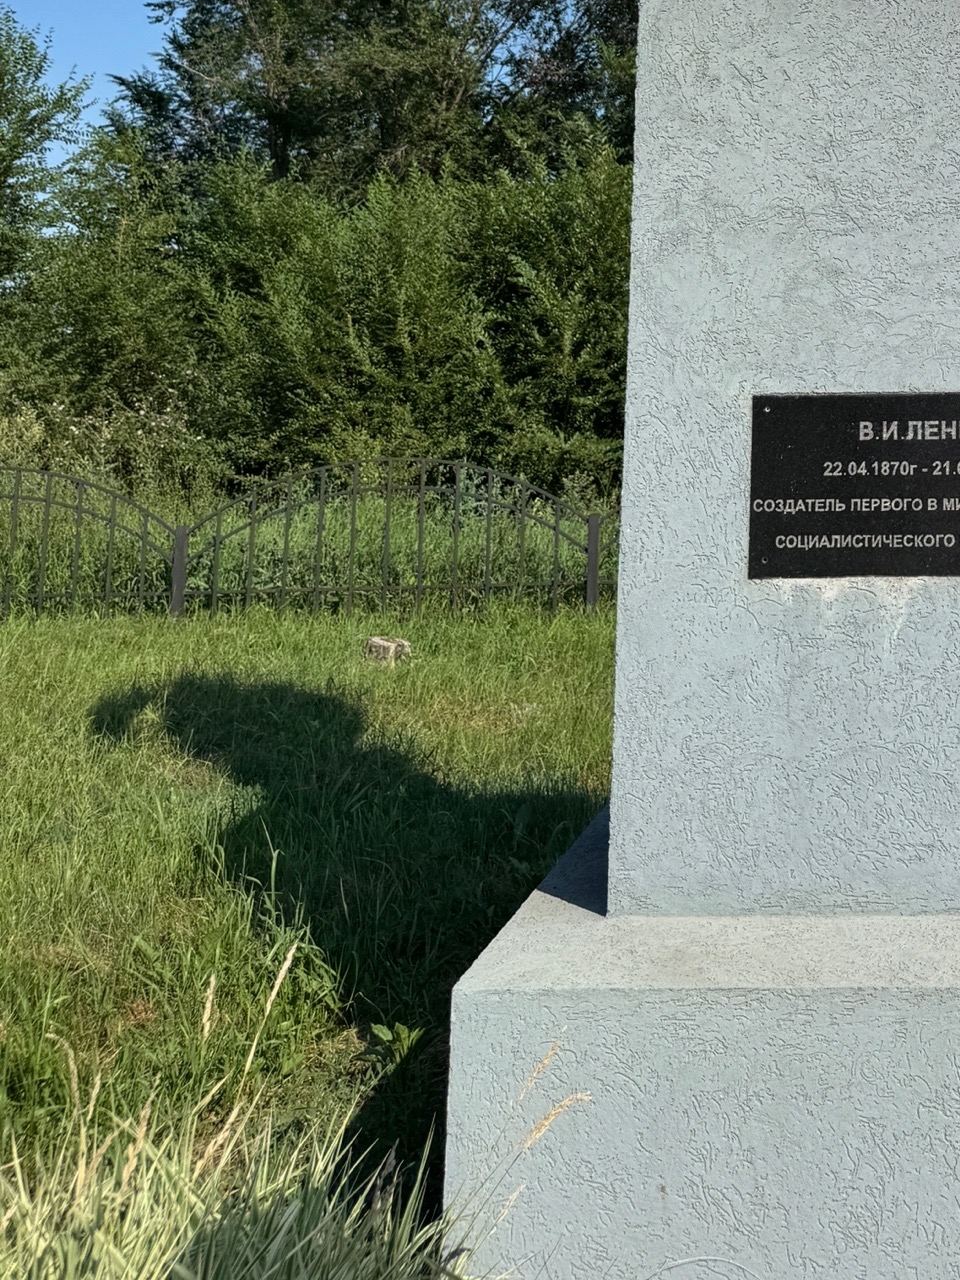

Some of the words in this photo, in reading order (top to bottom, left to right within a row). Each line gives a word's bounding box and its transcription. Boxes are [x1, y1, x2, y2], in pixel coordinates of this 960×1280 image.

[823, 461, 918, 476] 22.04.1870г
[753, 499, 846, 514] СОЗДАТЕЛЬ
[850, 498, 923, 511] ПЕРВОГО
[927, 497, 938, 511] В
[775, 534, 956, 550] СОЦИАЛИСТИЧЕСКОГО
